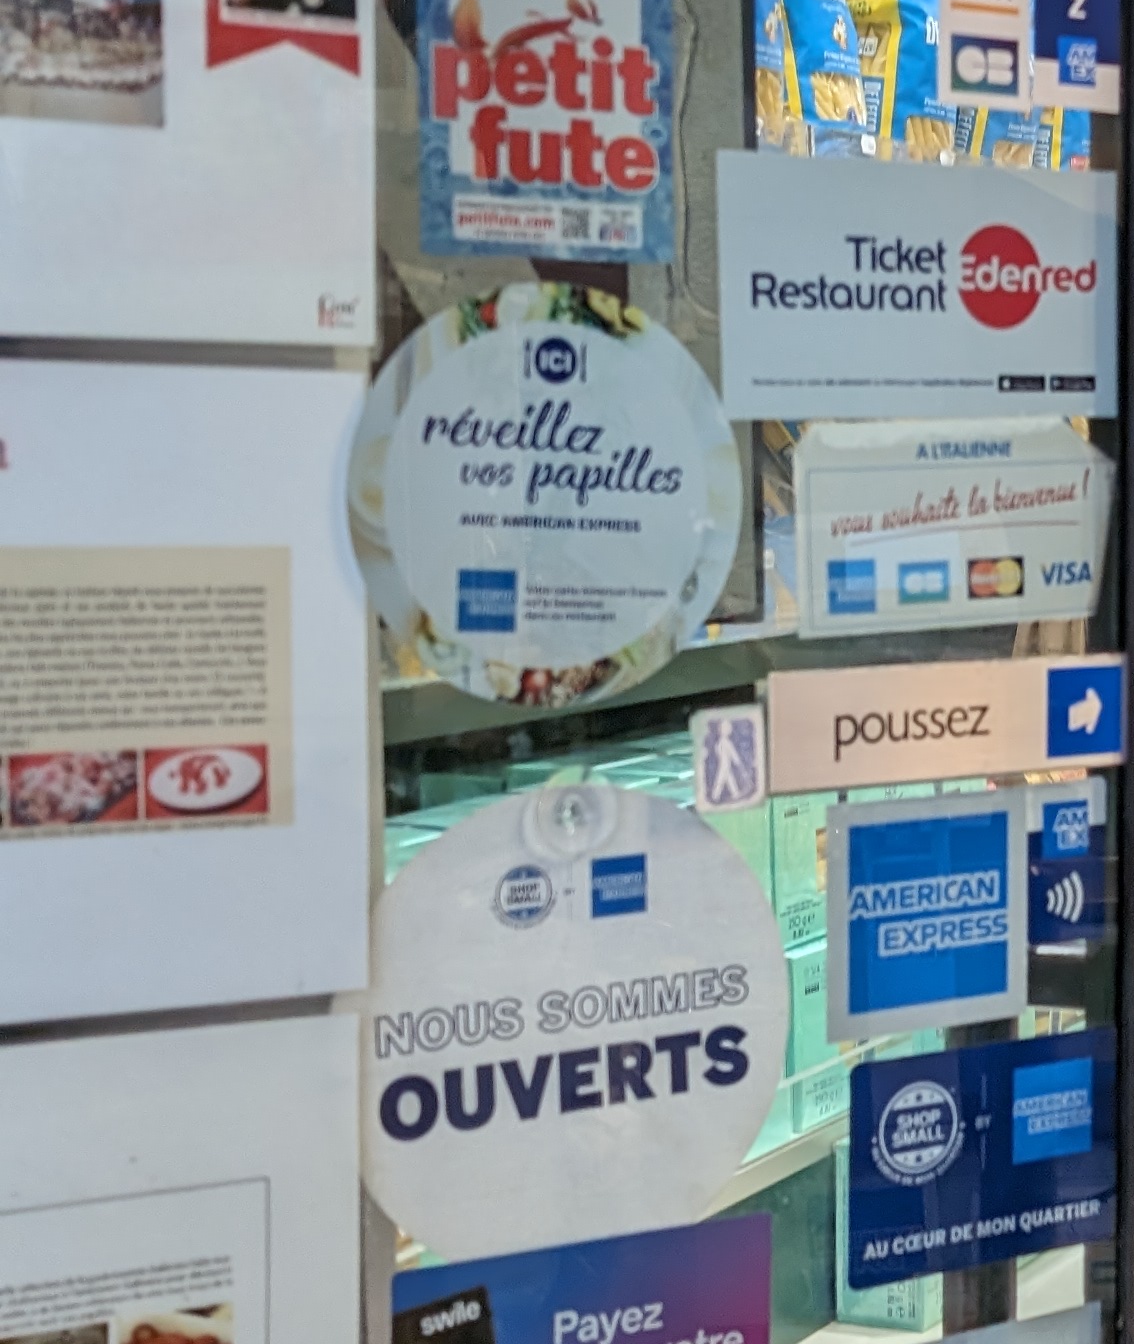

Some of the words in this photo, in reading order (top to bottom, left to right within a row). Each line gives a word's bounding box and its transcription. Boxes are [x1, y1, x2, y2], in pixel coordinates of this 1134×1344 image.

[432, 37, 658, 120] petit
[844, 233, 948, 275] Ticket
[958, 253, 1098, 295] Edenred
[749, 271, 948, 313] Restaurant
[421, 399, 606, 455] réveillez
[459, 461, 515, 487] vos
[526, 445, 684, 507] papilles
[1041, 560, 1093, 587] VISA
[833, 702, 992, 763] poussez
[850, 872, 998, 918] AMERICAN
[880, 911, 1008, 955] EXPRESS
[374, 996, 525, 1059] NOUS
[537, 962, 750, 1035] SOMMES
[378, 1024, 751, 1142] OUVERTS
[890, 1124, 946, 1149] SMALL
[896, 1108, 942, 1132] SHOP
[863, 1239, 889, 1262] AU
[950, 1223, 974, 1243] DE
[976, 1214, 1017, 1238] MON
[1018, 1198, 1102, 1235] QUARTIER
